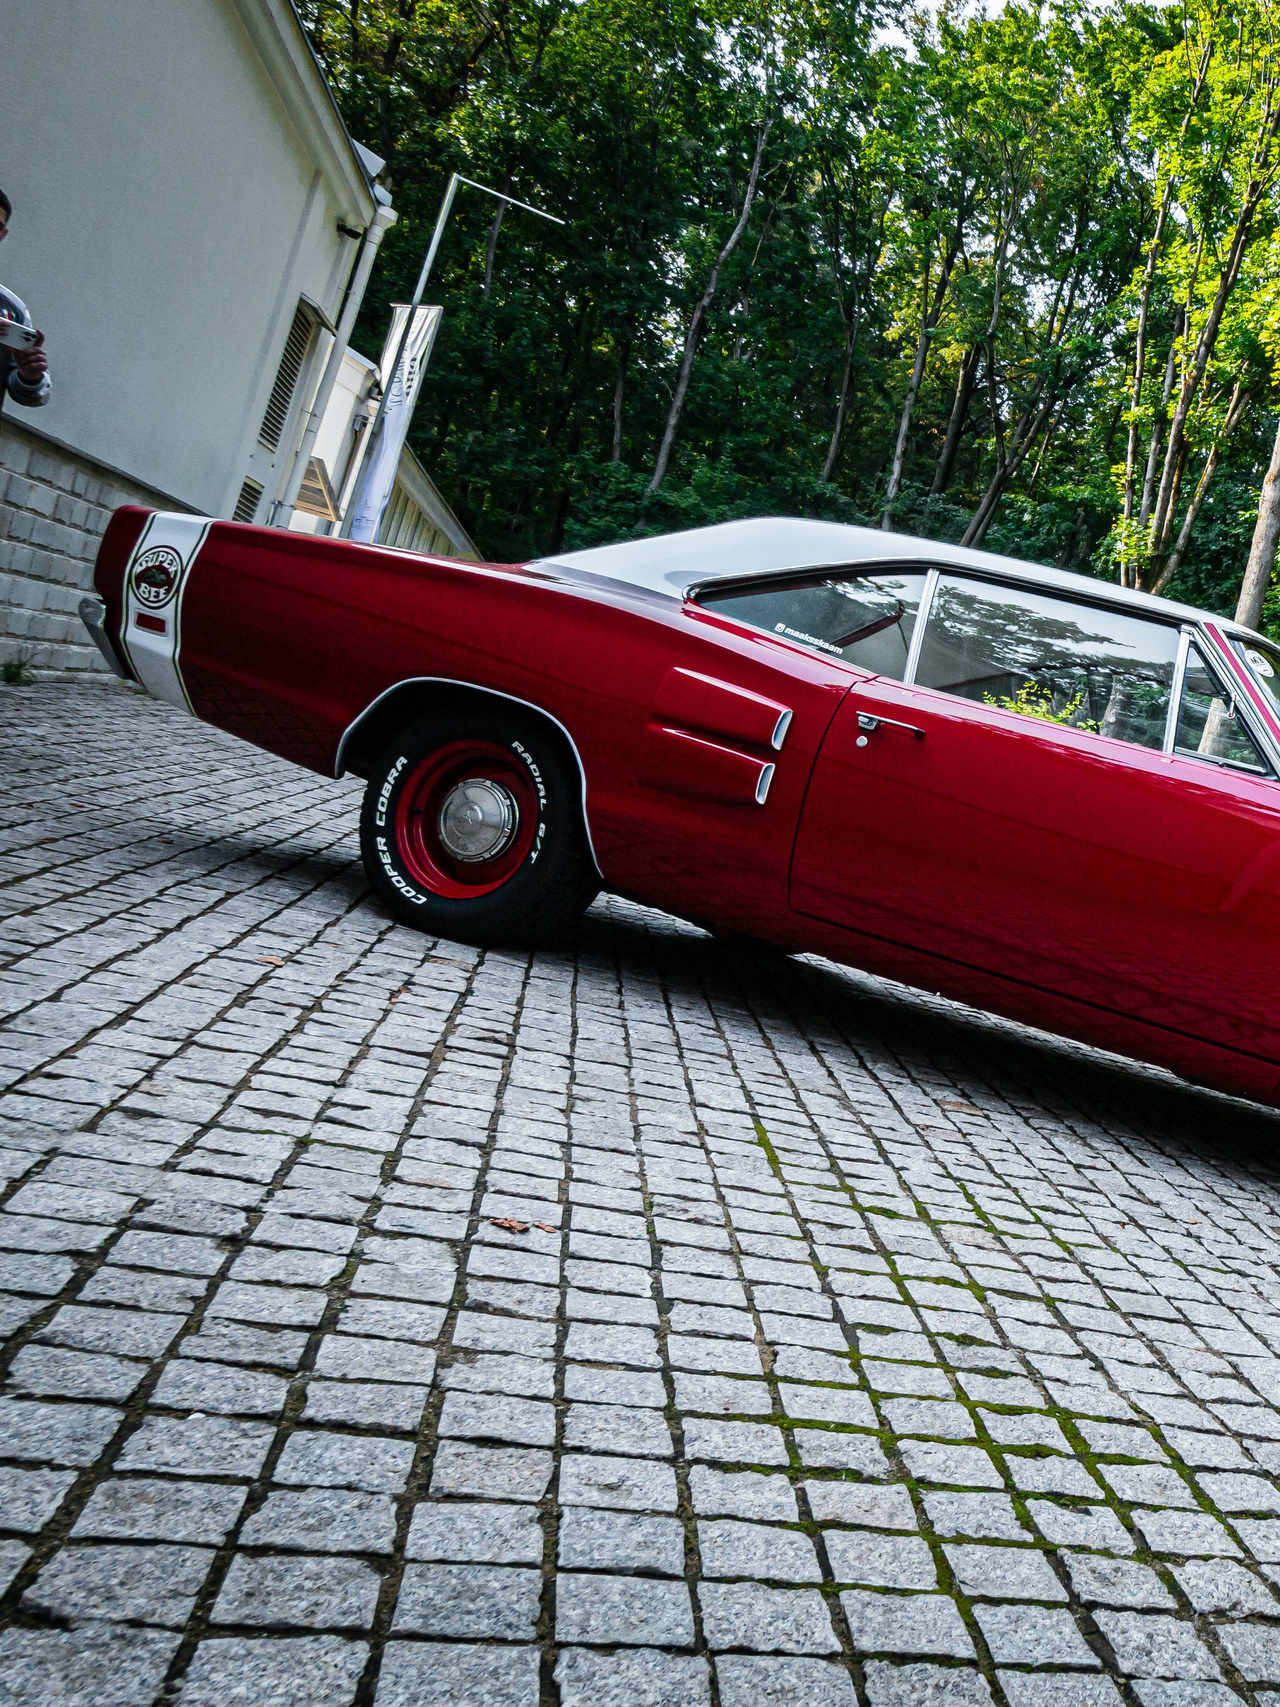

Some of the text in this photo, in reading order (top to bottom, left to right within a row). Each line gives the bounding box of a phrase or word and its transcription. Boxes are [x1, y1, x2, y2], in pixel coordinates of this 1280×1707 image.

[138, 551, 177, 601] SUPER BEE
[784, 627, 843, 655] maaksskaam
[511, 741, 547, 811] RADIAL
[376, 756, 428, 905] COOPER COBRA
